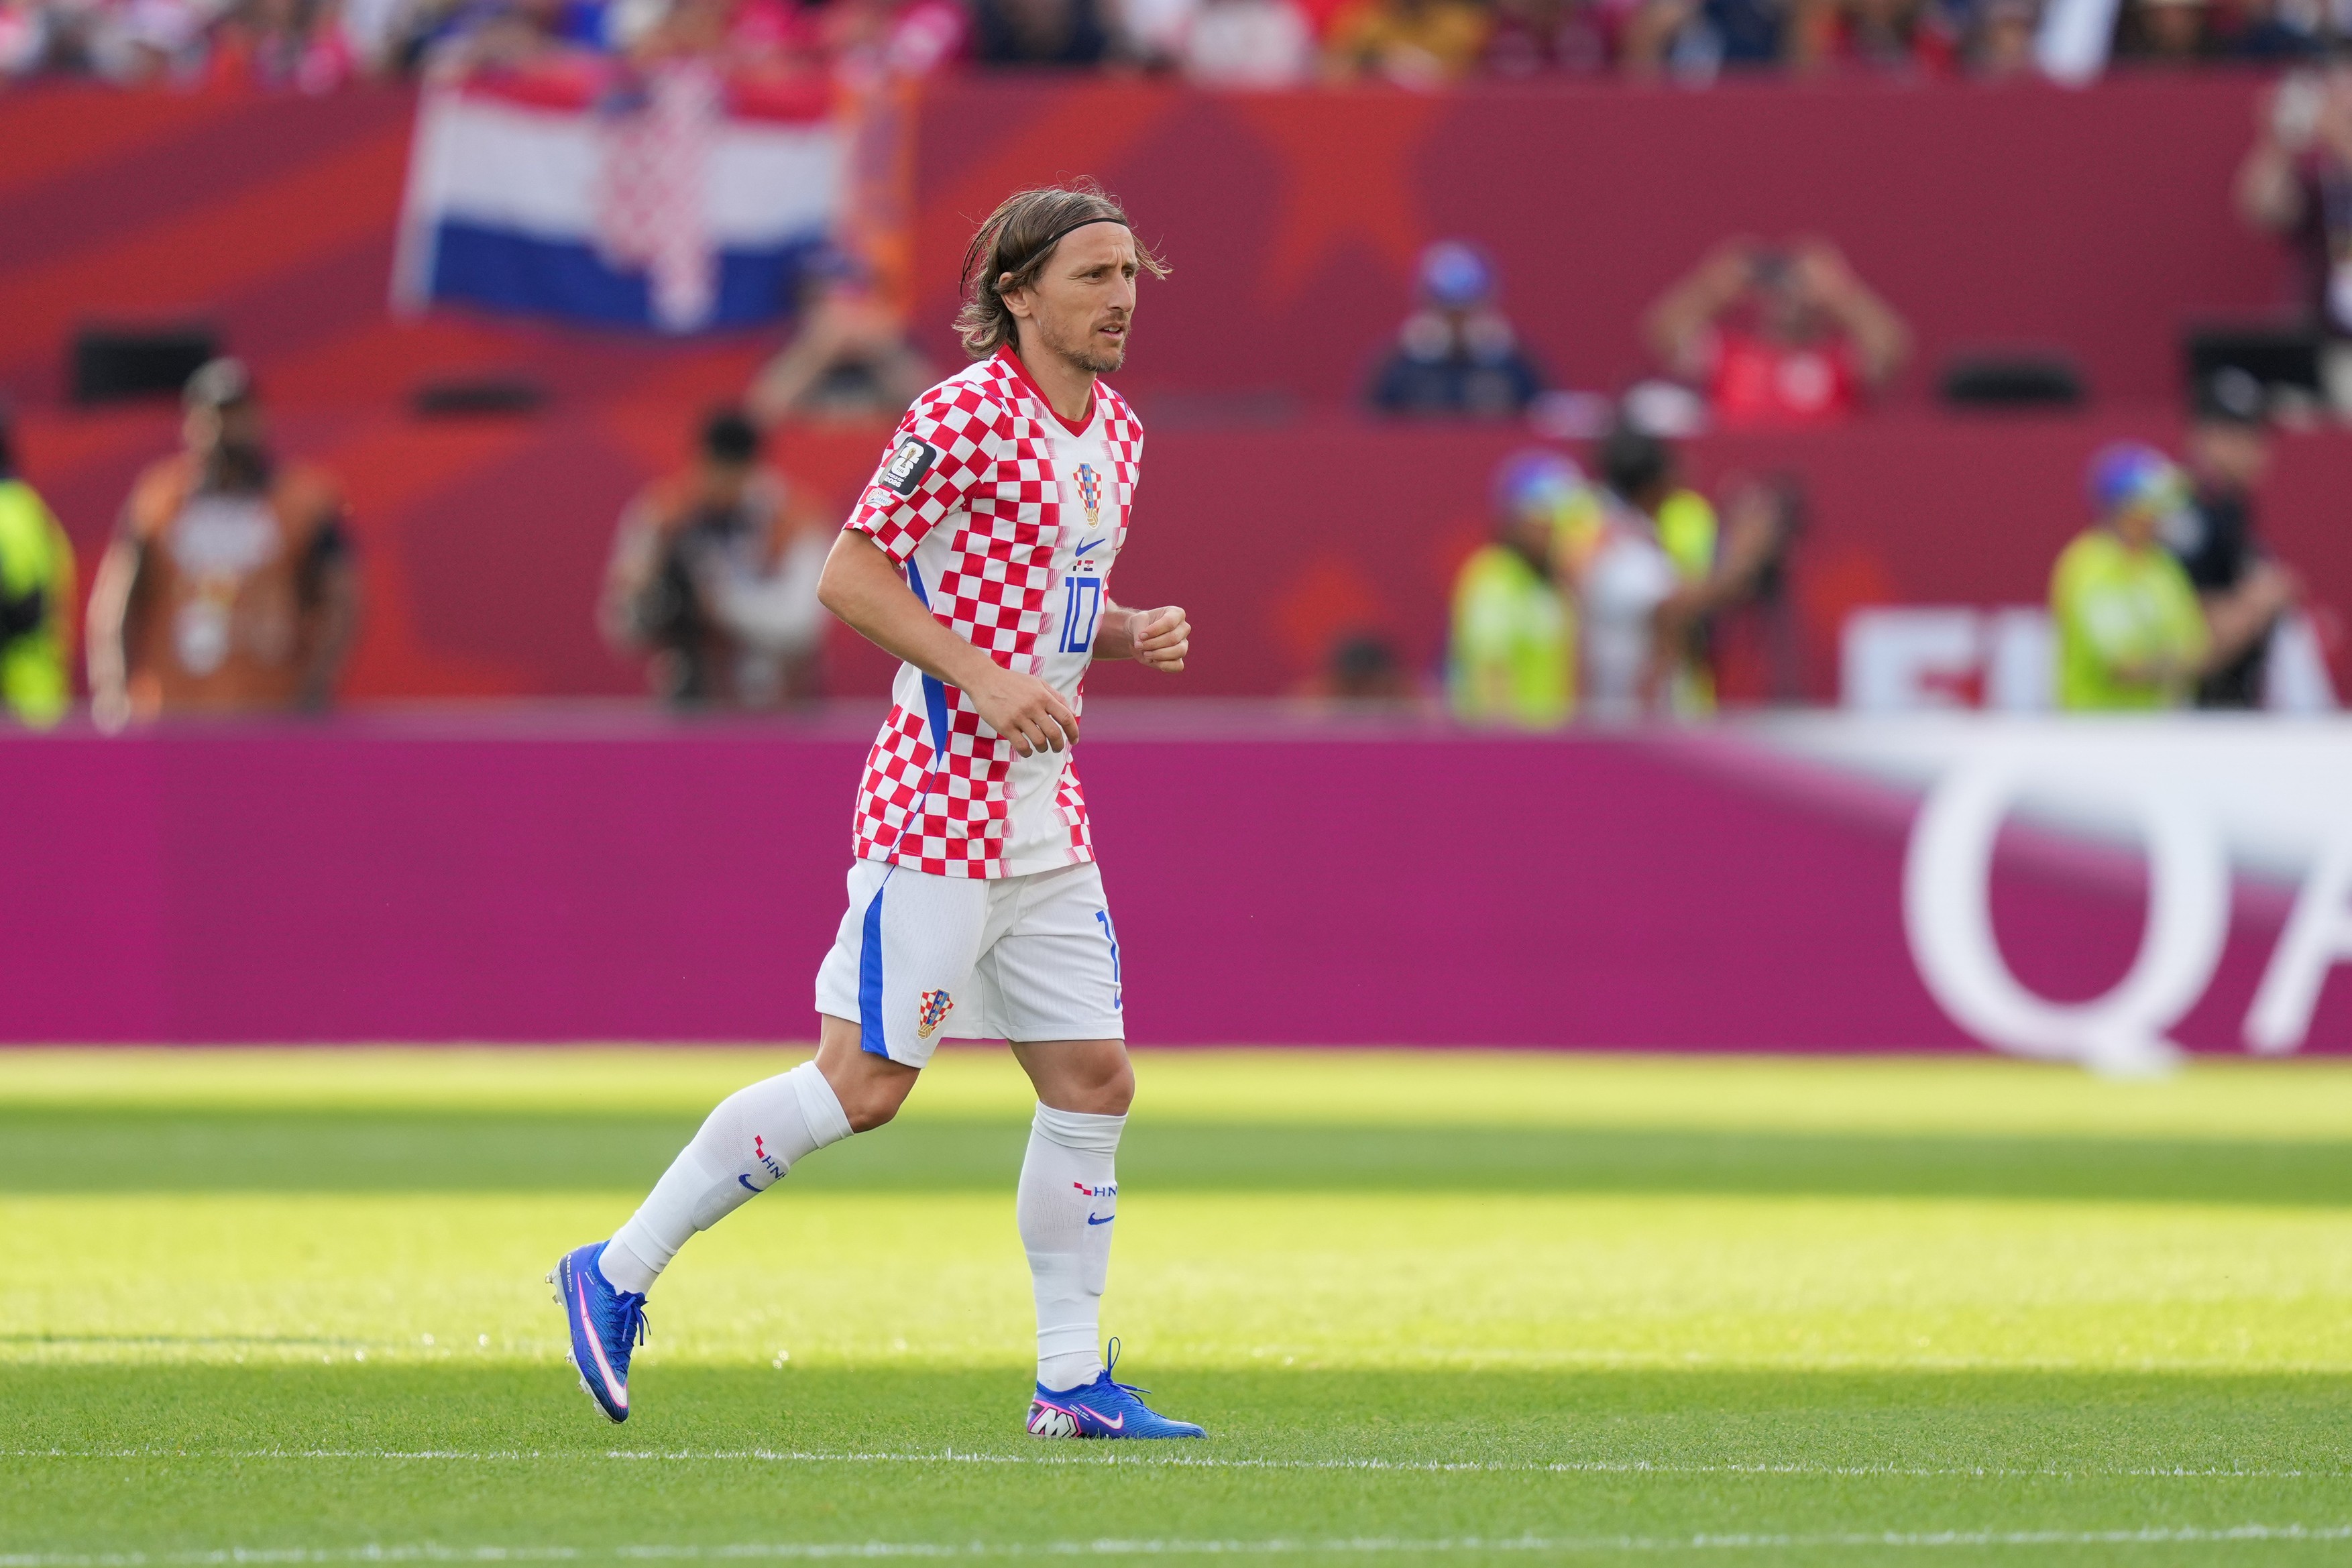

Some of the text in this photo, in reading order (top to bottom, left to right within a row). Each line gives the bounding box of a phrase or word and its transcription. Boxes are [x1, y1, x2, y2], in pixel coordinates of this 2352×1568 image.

[884, 475, 902, 488] 2026
[1059, 577, 1100, 653] 10
[761, 1155, 787, 1180] HN
